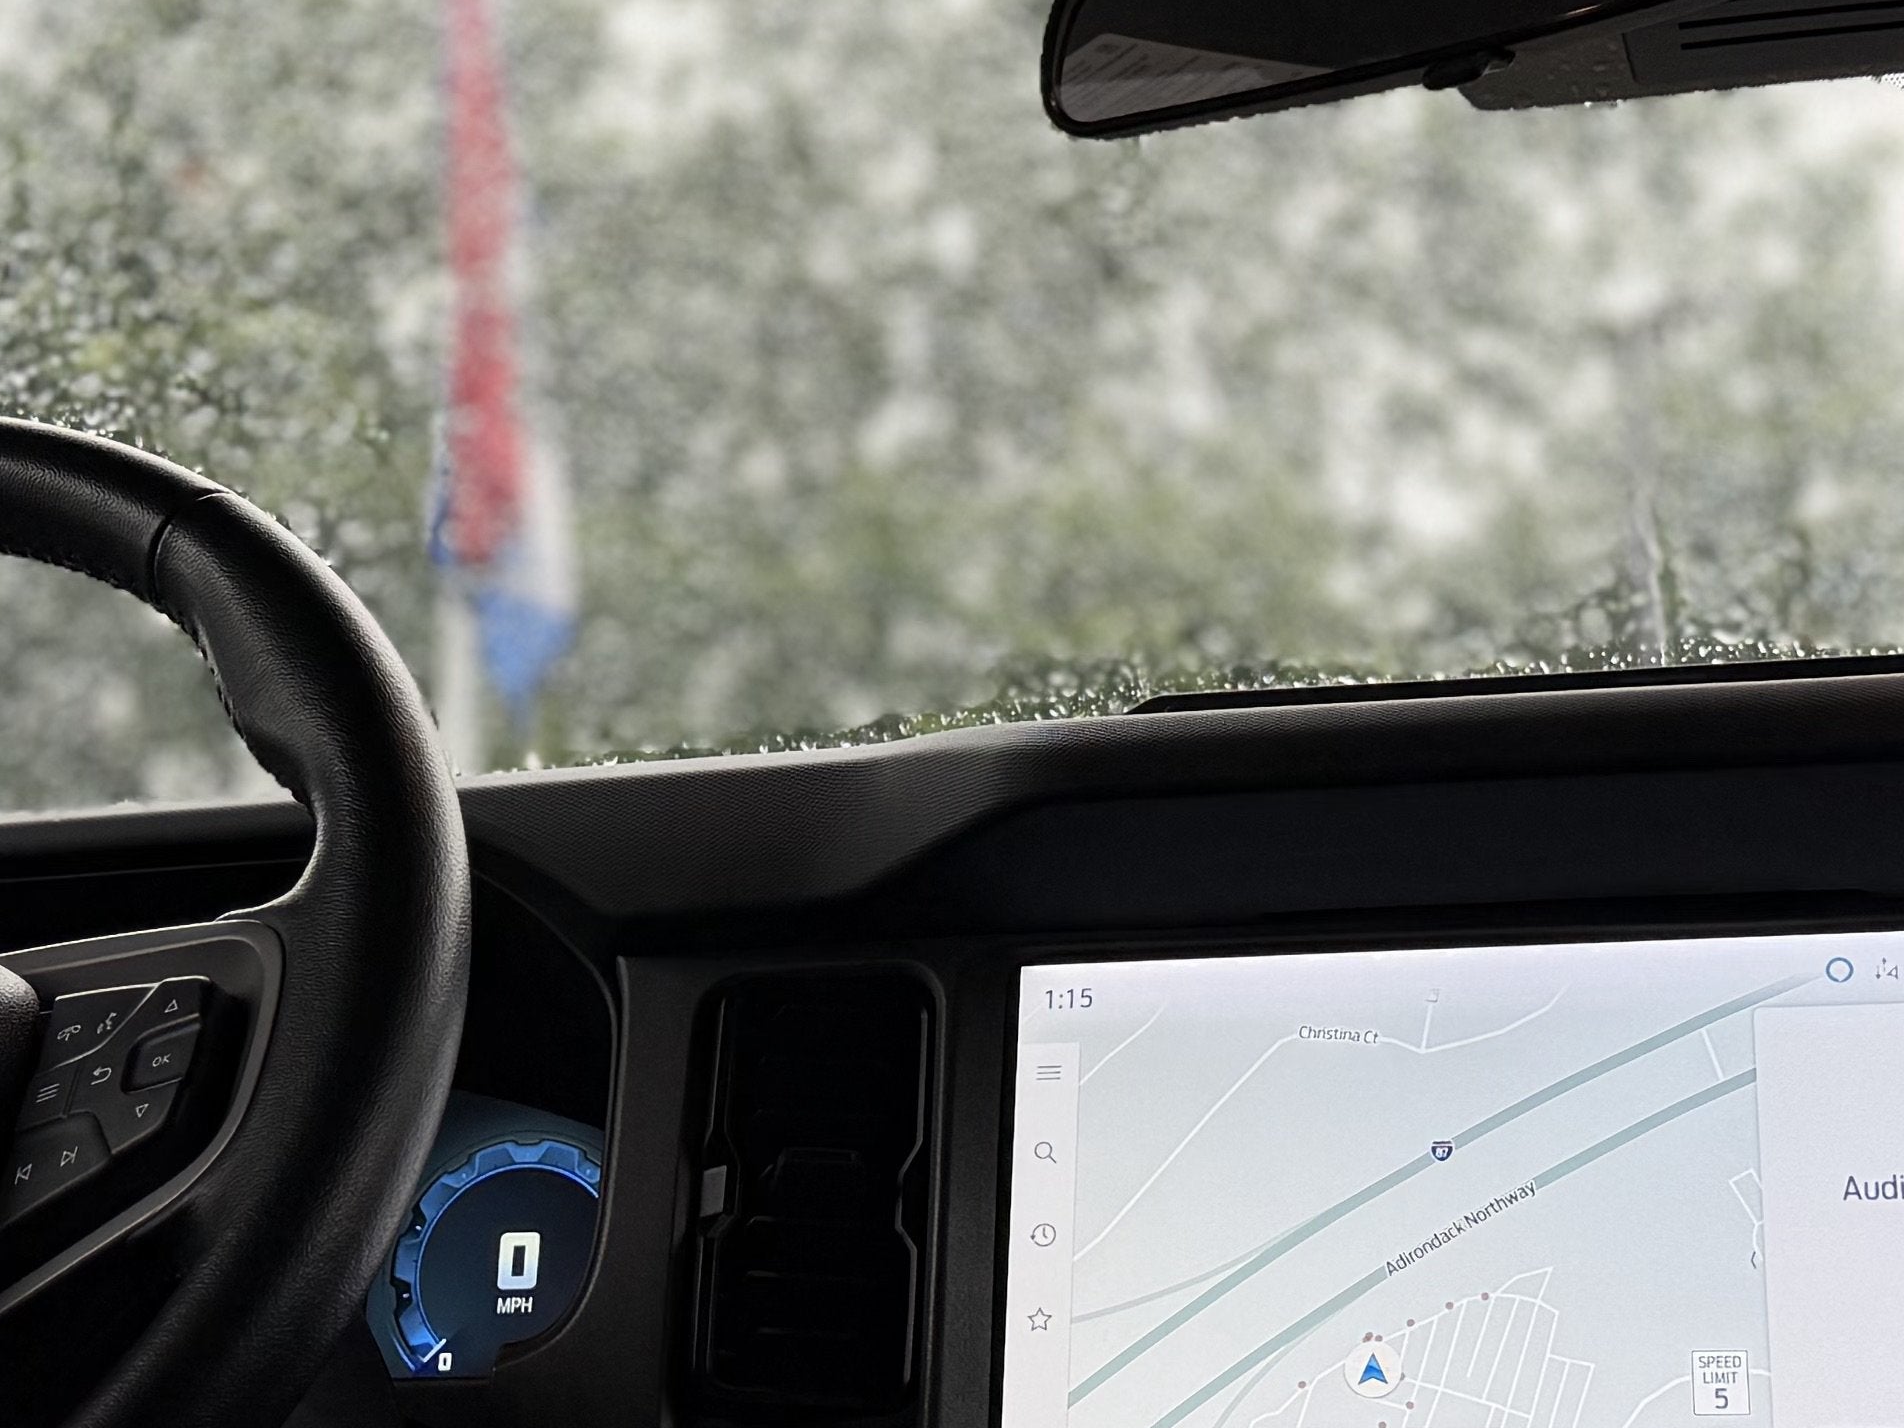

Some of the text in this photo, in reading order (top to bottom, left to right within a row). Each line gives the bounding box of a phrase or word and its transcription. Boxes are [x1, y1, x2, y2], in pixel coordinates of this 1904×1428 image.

[1045, 987, 1093, 1010] 1:15
[1298, 1025, 1379, 1045] Christina Ct
[152, 1053, 172, 1068] OK
[1435, 1147, 1449, 1159] 87
[1385, 1181, 1537, 1276] Adirondack Northway
[497, 1231, 541, 1290] 0
[496, 1296, 533, 1314] MPH
[438, 1352, 453, 1371] 0
[1698, 1355, 1742, 1369] SPEED
[1702, 1372, 1738, 1384] LIMIT
[1714, 1388, 1729, 1409] 5
